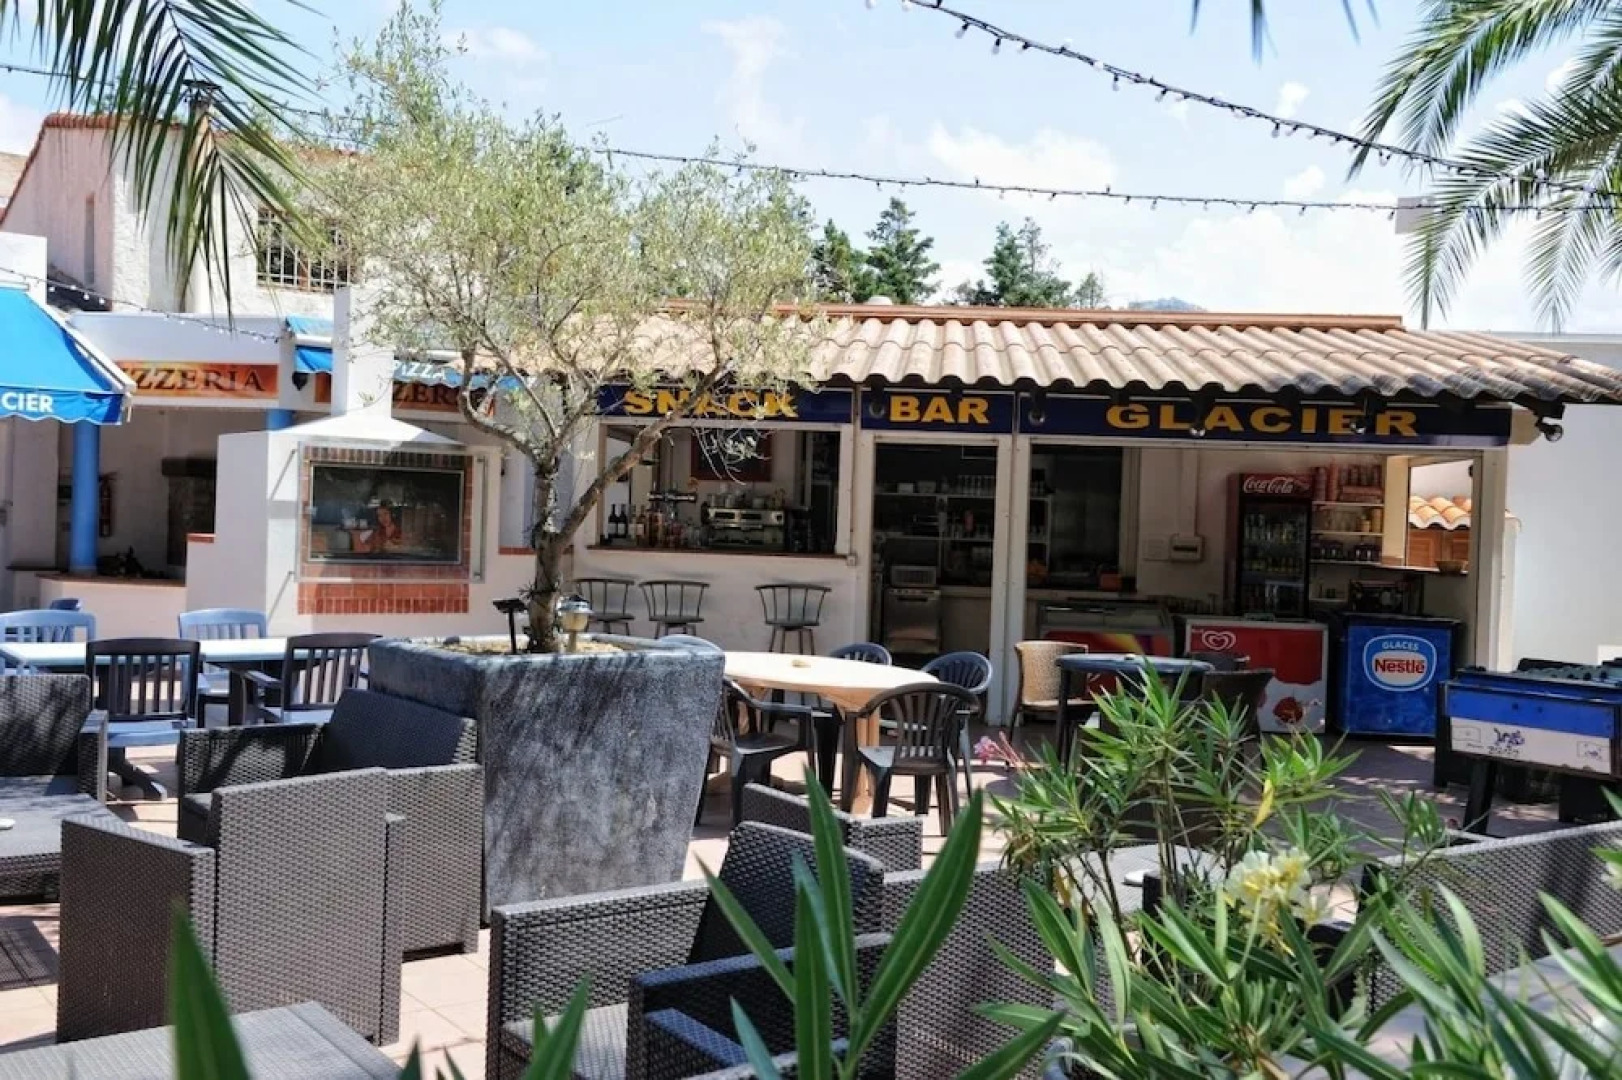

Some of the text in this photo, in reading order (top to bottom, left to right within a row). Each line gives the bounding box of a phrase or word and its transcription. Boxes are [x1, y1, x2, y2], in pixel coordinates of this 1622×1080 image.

[1, 391, 53, 413] CIER
[889, 395, 990, 424] BAR
[1105, 403, 1418, 437] GLACIER
[1382, 641, 1419, 651] GLACES
